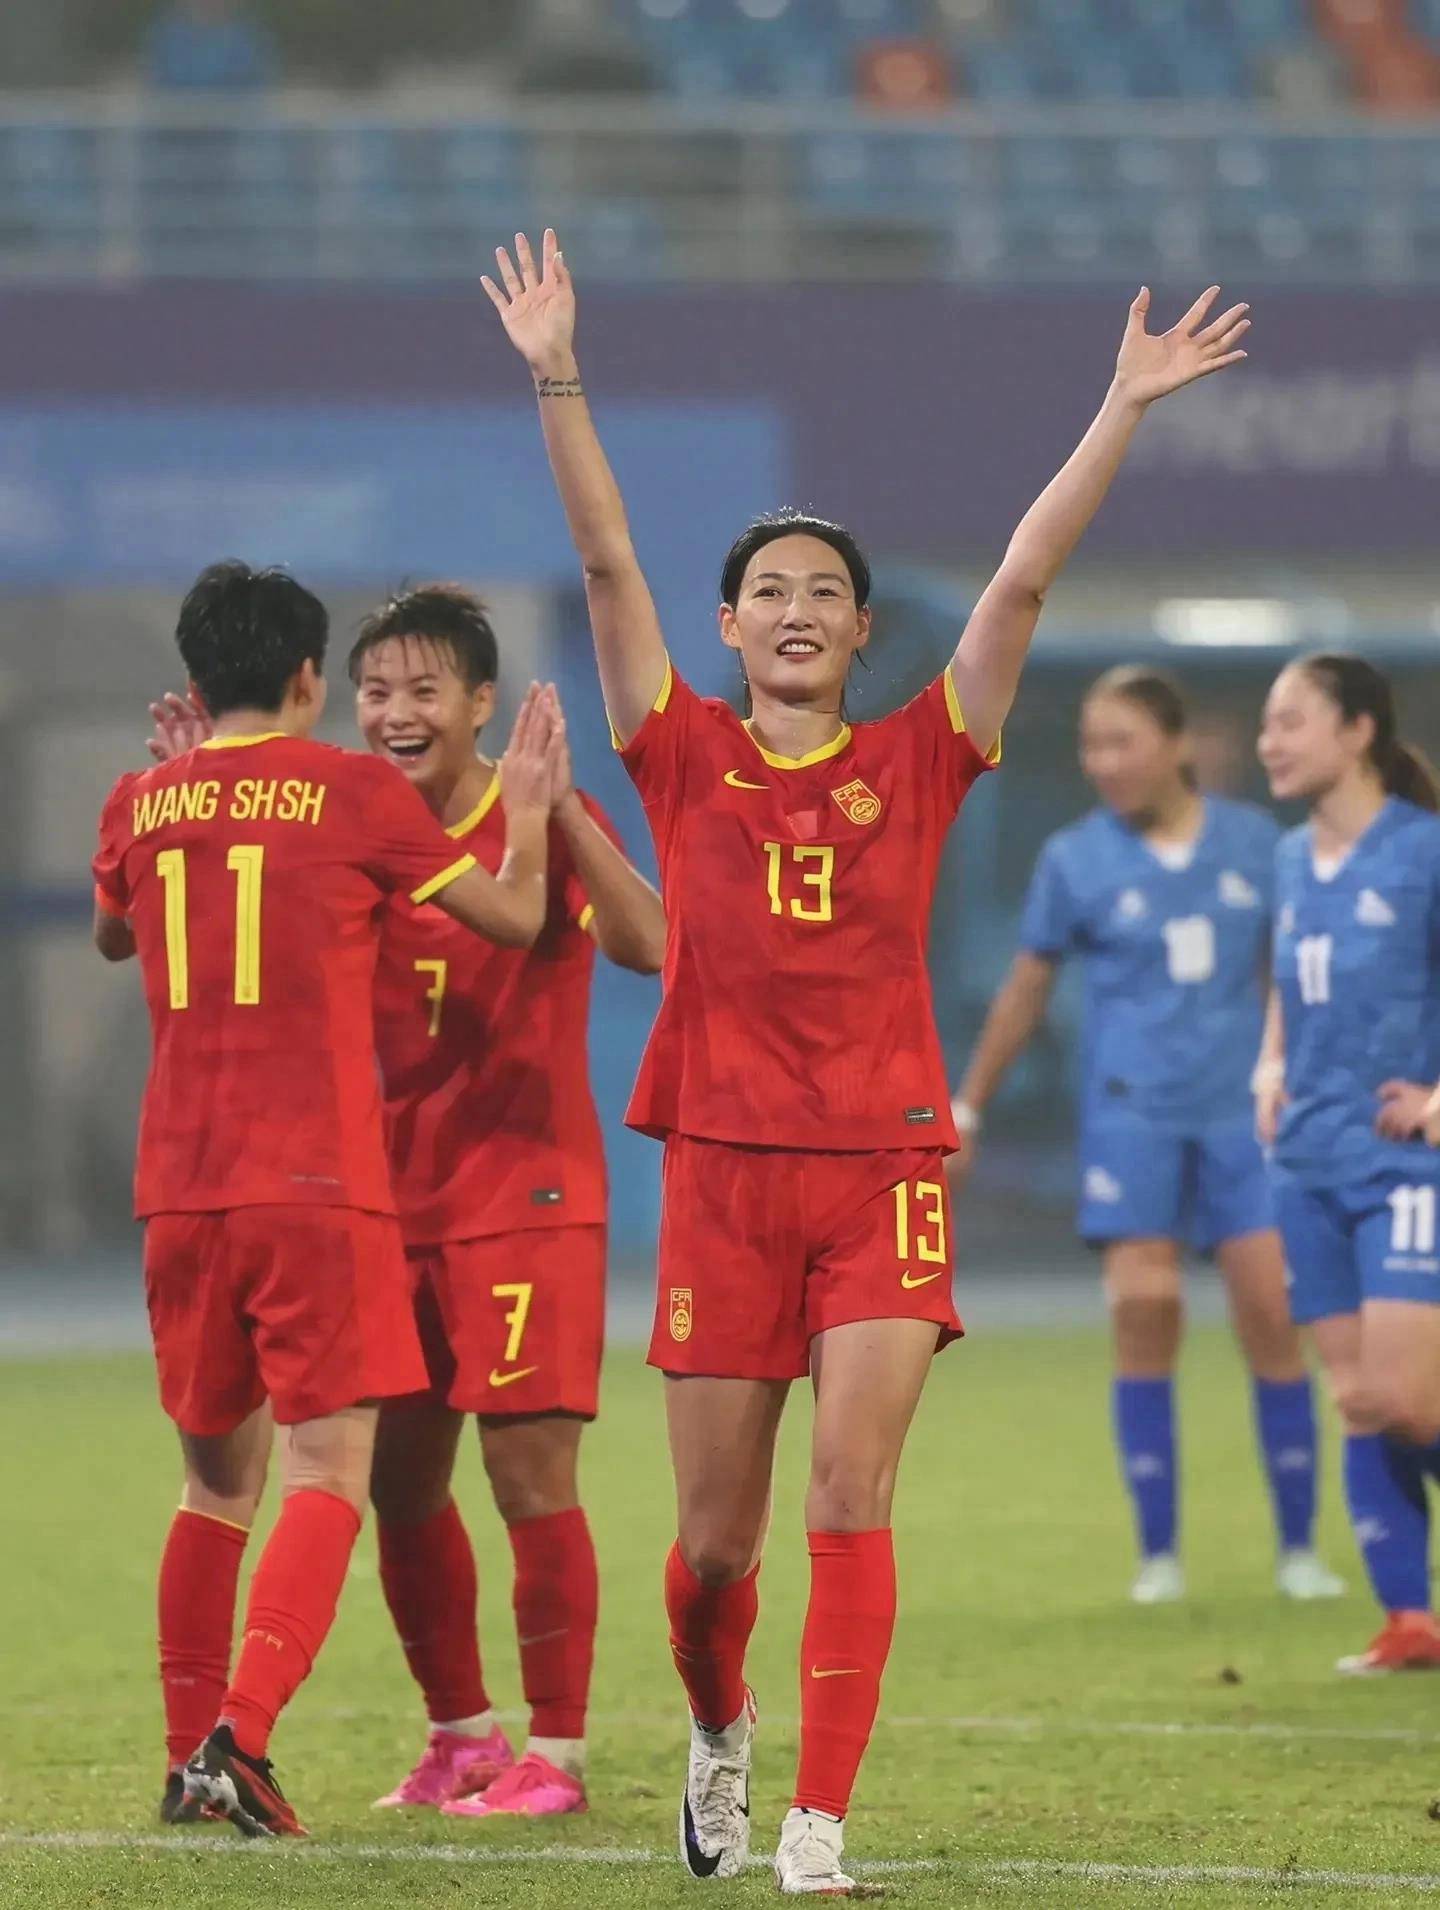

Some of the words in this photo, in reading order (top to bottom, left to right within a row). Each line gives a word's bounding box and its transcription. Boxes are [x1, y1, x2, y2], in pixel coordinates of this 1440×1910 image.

[133, 780, 221, 837] WANG
[229, 779, 326, 825] SHSH
[763, 841, 834, 921] 13
[156, 844, 264, 1010] 11
[414, 959, 447, 1037] 7
[1296, 933, 1333, 1005] 11
[890, 1180, 947, 1264] 13
[1386, 1184, 1436, 1252] 11
[492, 1283, 532, 1361] 7
